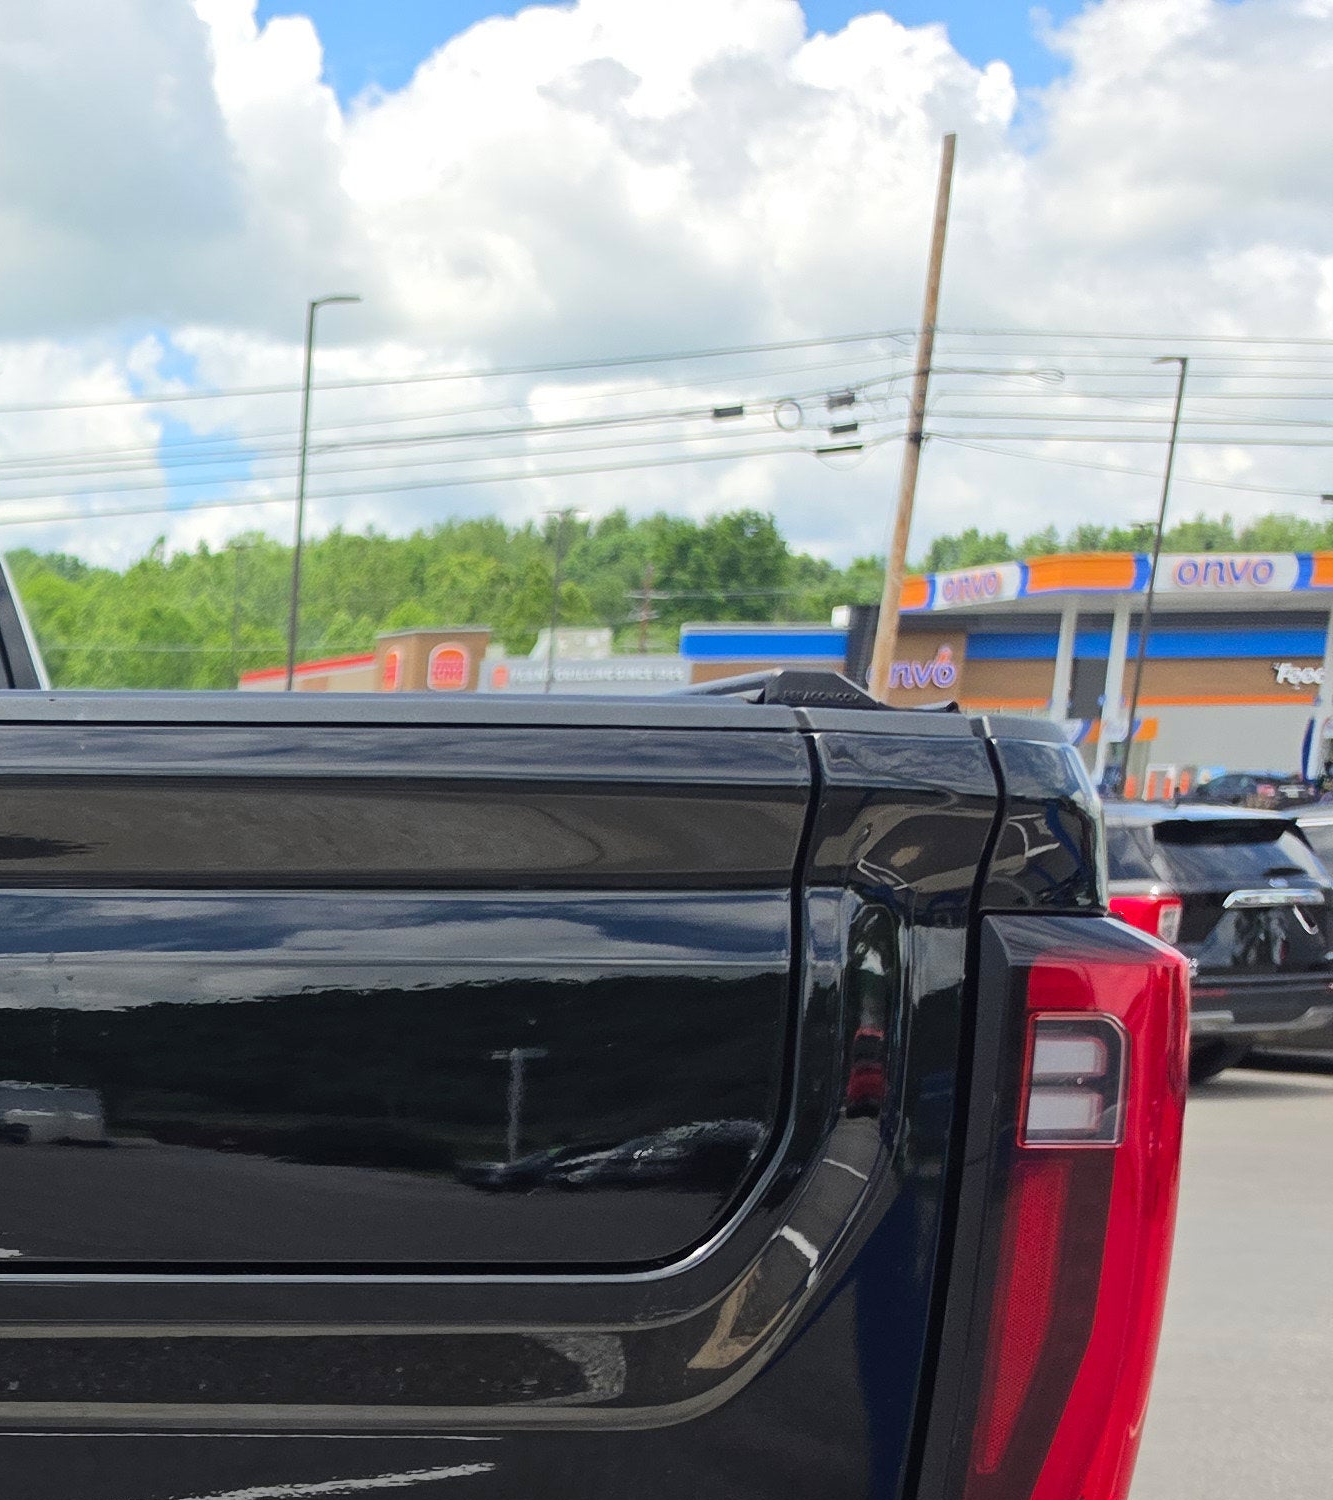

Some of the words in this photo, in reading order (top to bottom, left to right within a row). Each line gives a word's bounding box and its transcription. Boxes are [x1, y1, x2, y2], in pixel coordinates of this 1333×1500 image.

[942, 571, 1002, 602] onvo
[1174, 558, 1275, 586] onvo
[866, 657, 957, 689] nvo
